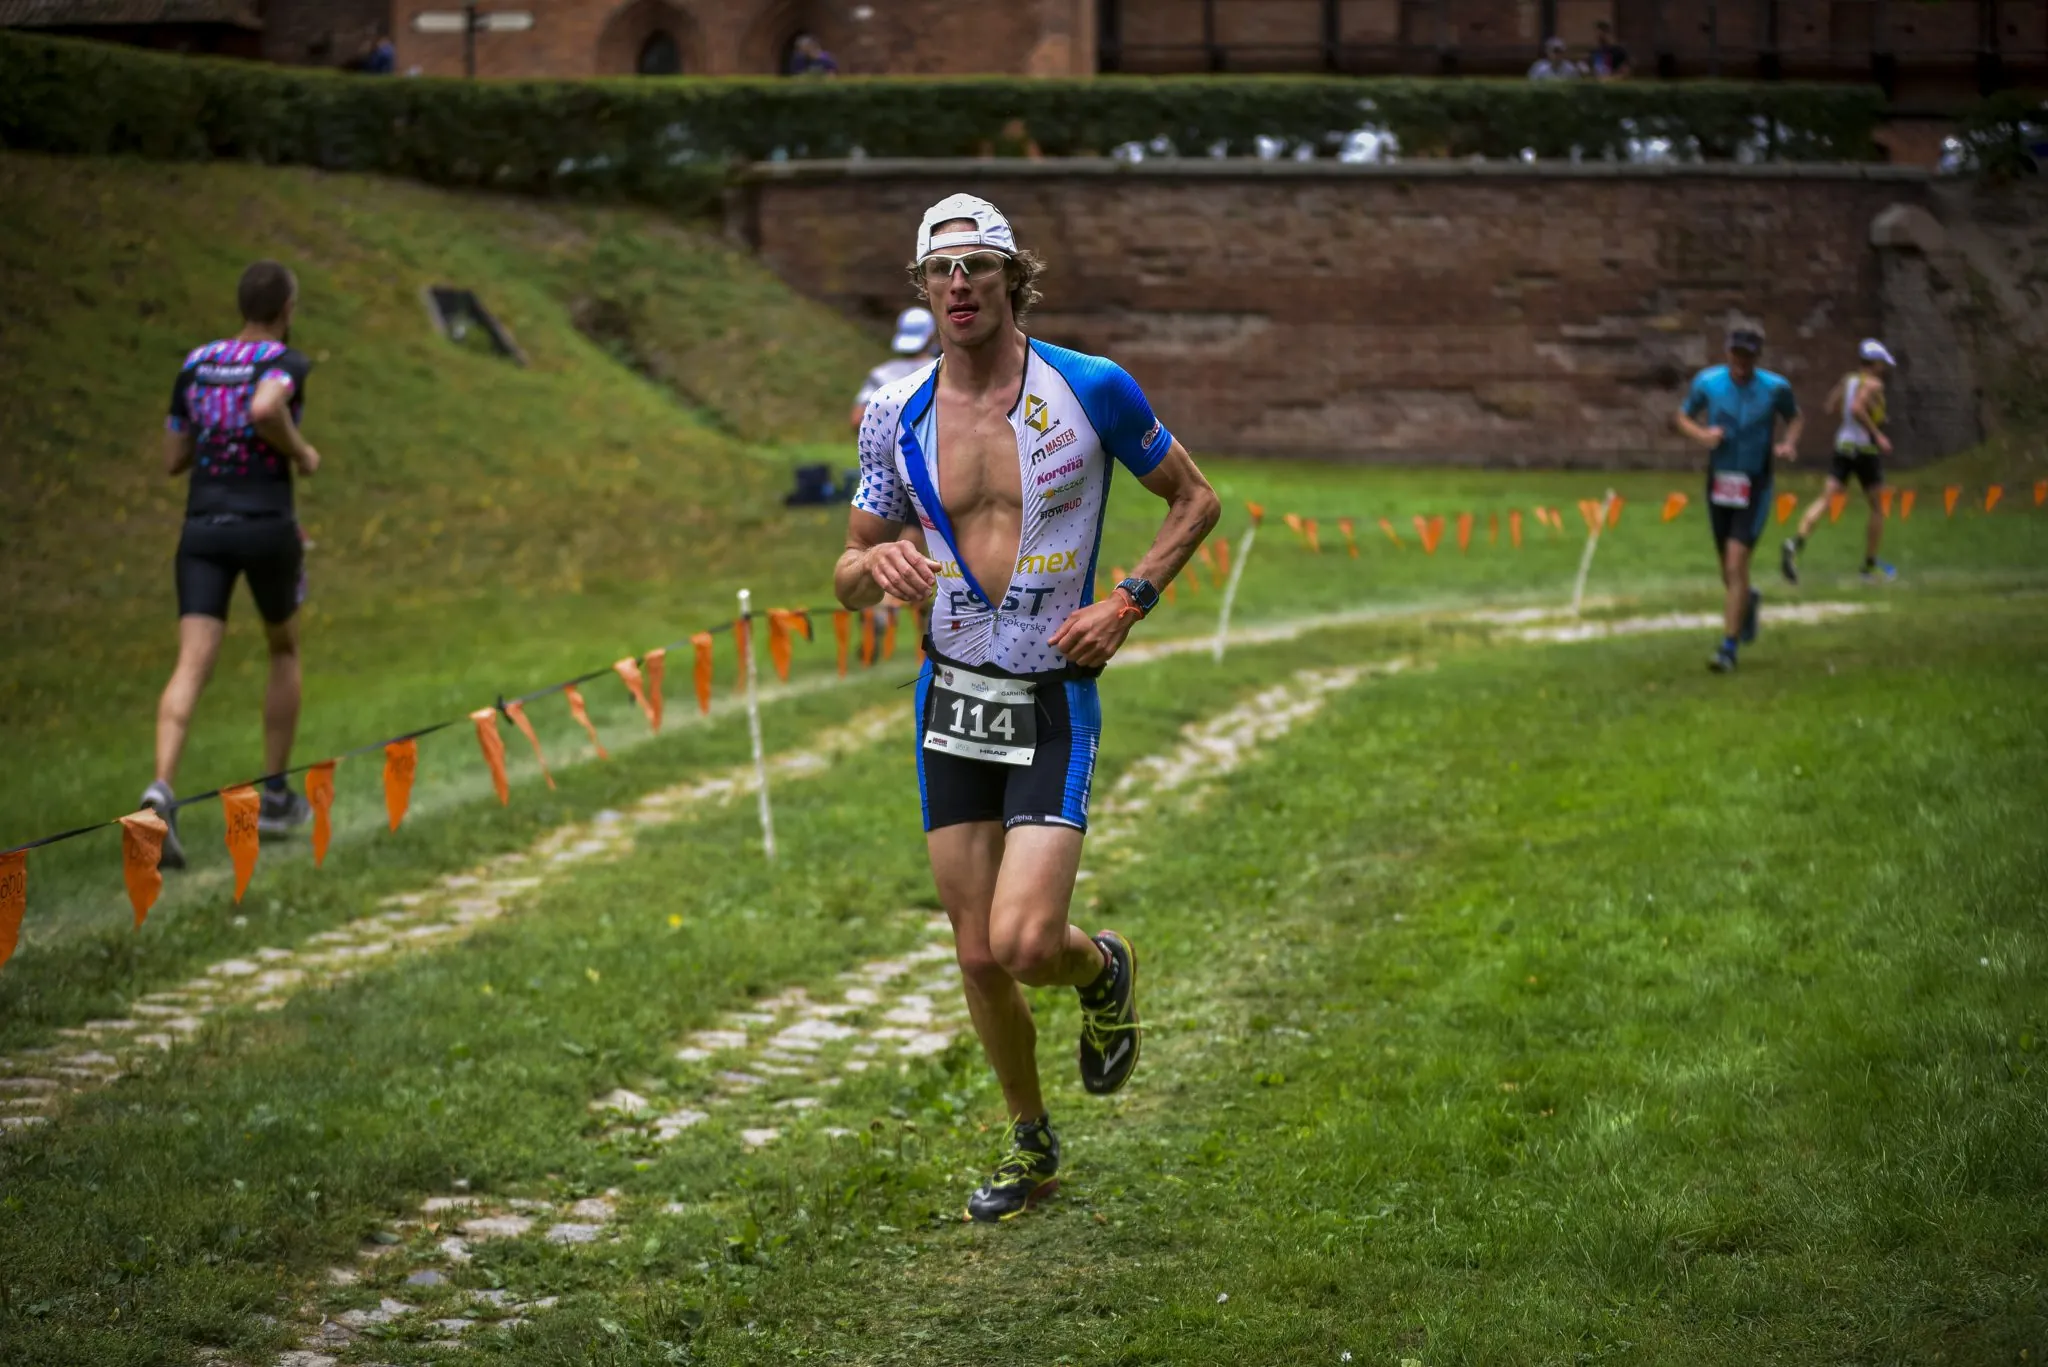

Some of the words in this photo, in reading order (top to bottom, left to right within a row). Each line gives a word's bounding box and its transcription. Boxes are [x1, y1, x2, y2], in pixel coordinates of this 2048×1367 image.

[1045, 428, 1077, 453] MASTER
[1036, 458, 1084, 486] Korona
[994, 614, 1047, 632] Brokerska
[950, 698, 1016, 741] 114
[979, 748, 1007, 757] HEAD
